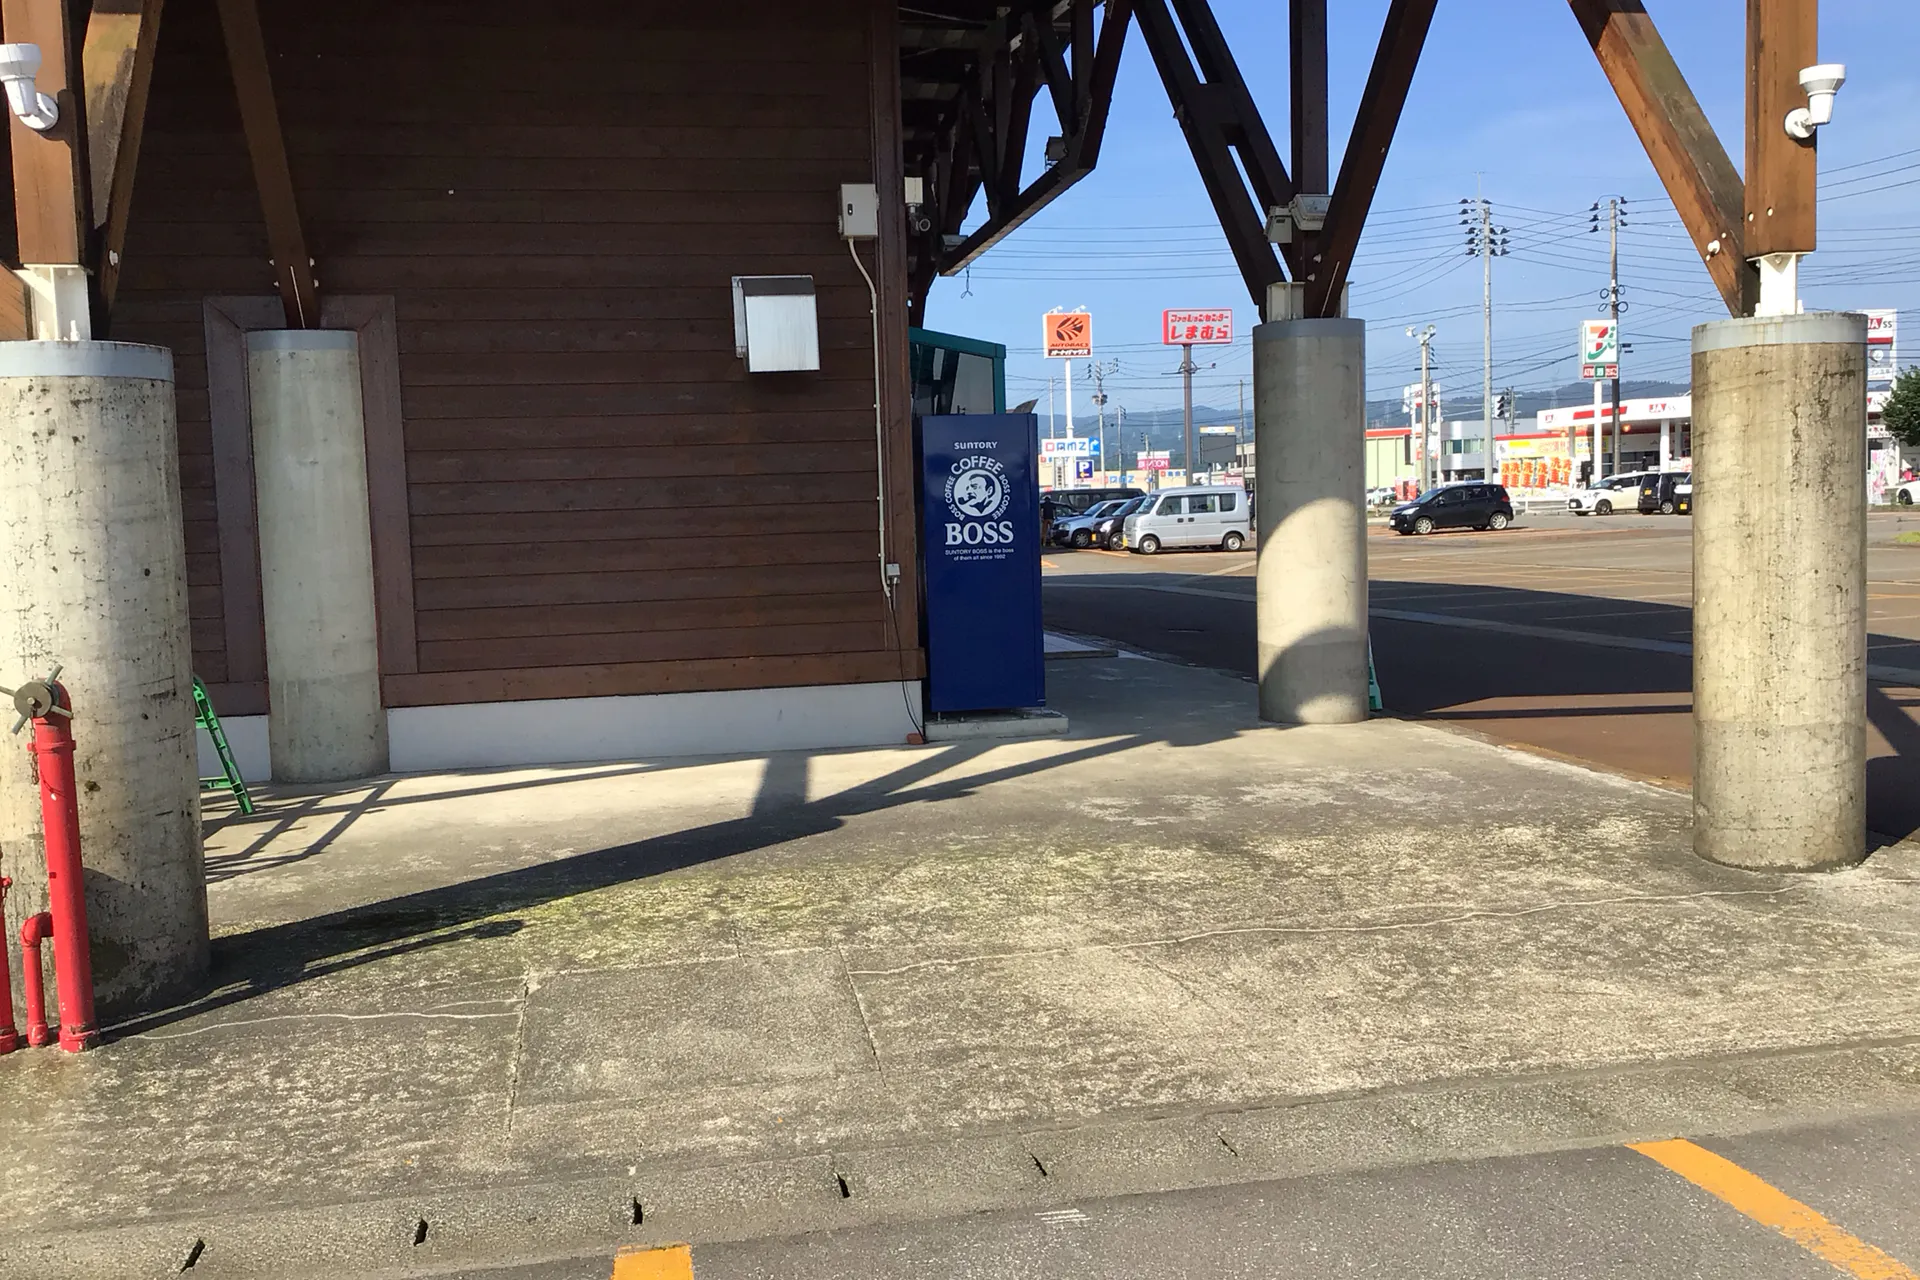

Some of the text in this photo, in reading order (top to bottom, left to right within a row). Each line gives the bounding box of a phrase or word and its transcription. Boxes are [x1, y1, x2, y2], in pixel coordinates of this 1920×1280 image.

[1171, 325, 1229, 340] しまむら
[954, 441, 998, 450] SUNTORY
[951, 455, 1004, 475] COFFEE
[1079, 461, 1090, 472] P
[944, 475, 966, 521] BOSS COFFEE
[991, 474, 1011, 520] BOSS COFFEE
[944, 520, 1014, 545] BOSS
